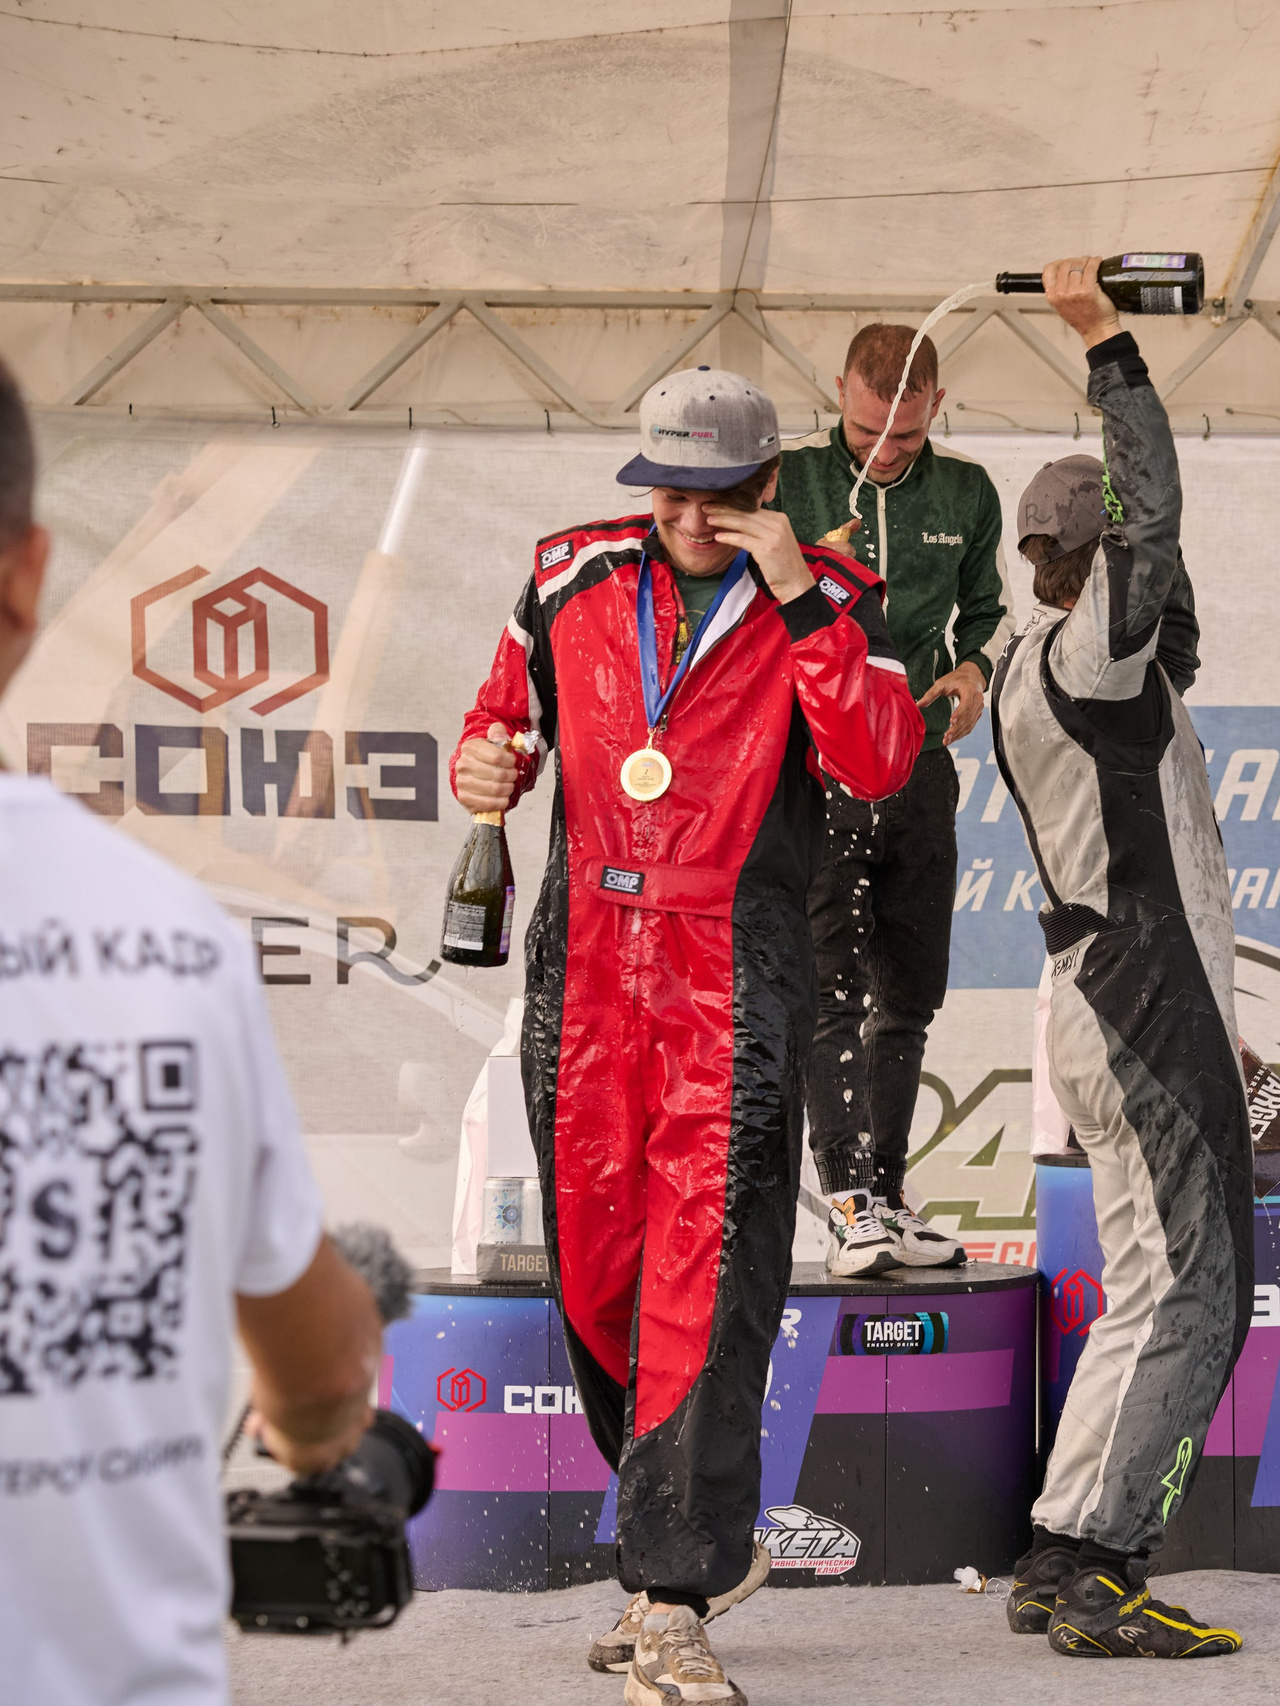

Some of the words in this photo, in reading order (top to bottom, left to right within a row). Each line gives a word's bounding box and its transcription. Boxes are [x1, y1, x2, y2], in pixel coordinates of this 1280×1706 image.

[658, 429, 690, 438] HYPER
[921, 532, 937, 543] Los
[542, 545, 569, 565] OMP
[819, 578, 850, 600] OMP
[27, 723, 439, 822] СОЮЗ
[606, 873, 639, 888] OMP
[1247, 1065, 1267, 1098] ENERG
[864, 1321, 922, 1341] TARGET
[816, 1566, 840, 1574] КЛУБ
